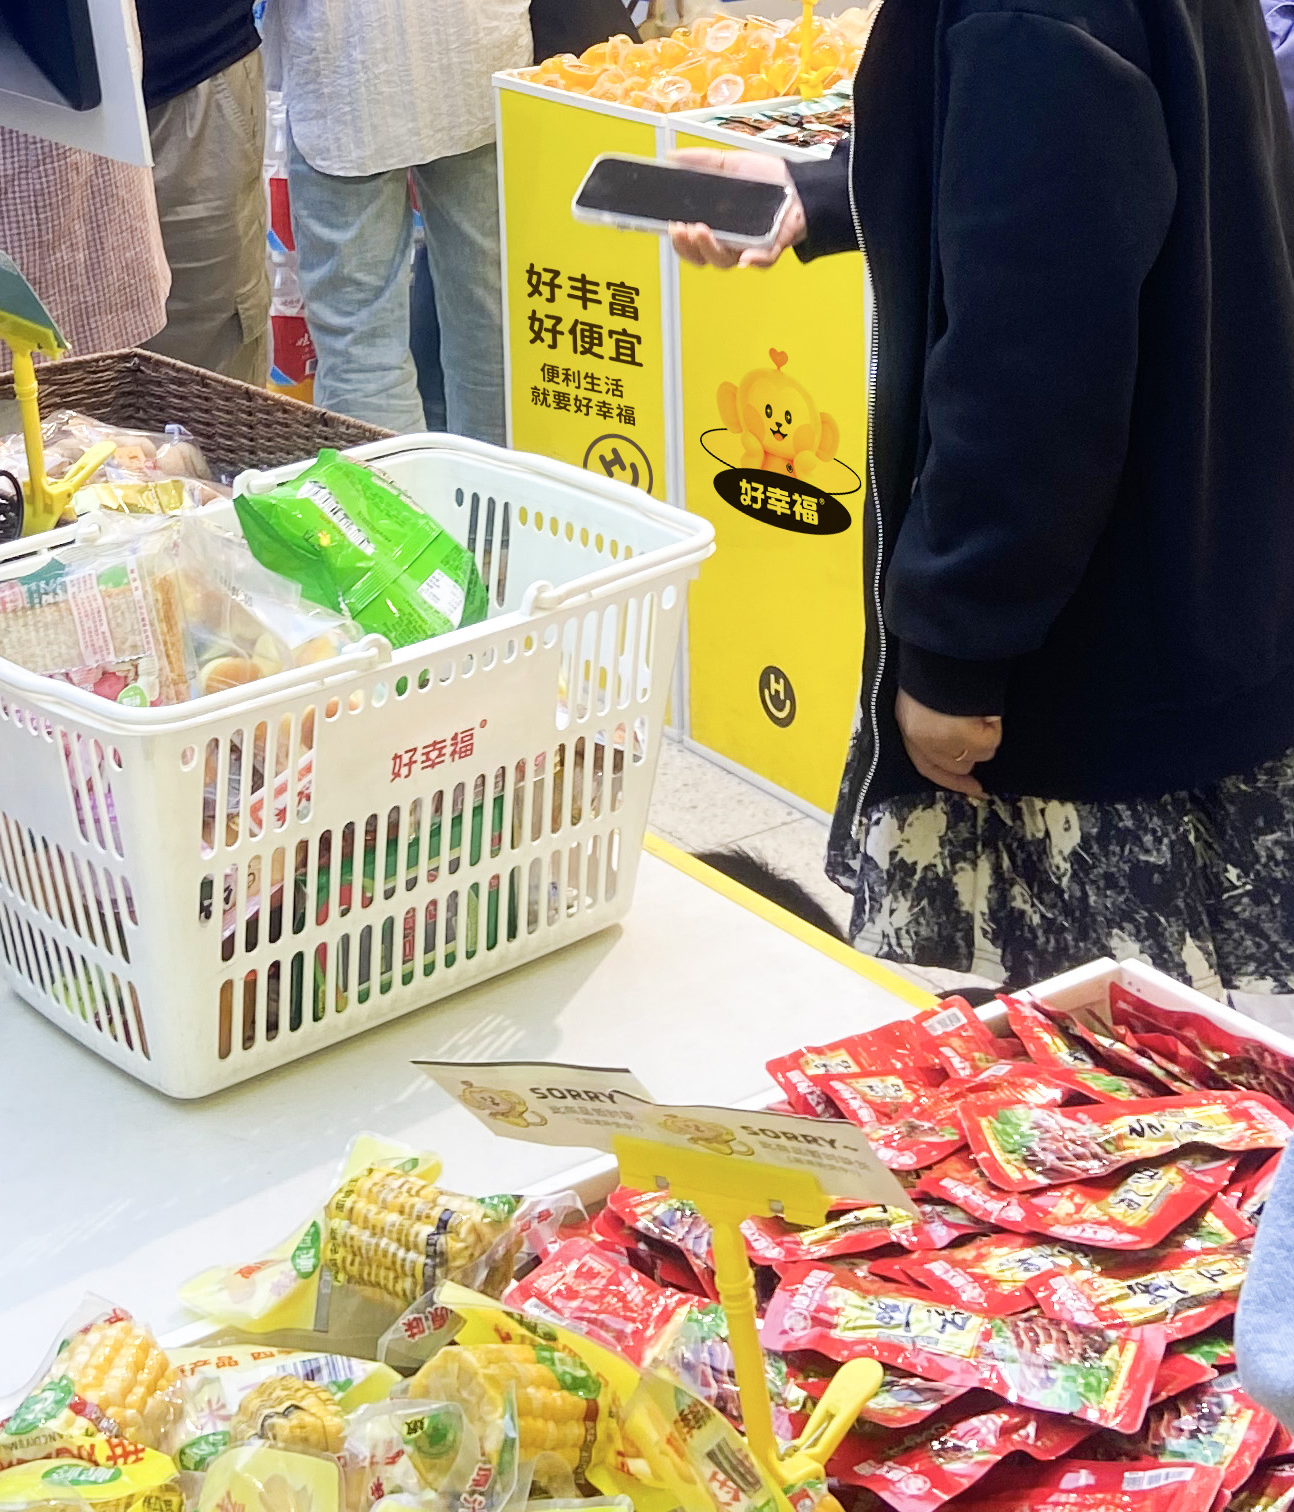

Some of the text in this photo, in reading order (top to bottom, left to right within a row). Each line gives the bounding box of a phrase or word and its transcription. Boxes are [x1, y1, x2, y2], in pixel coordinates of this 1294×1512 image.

[526, 263, 640, 321] 好丰富
[528, 310, 644, 368] 好便宜
[540, 363, 625, 399] 便利生活
[530, 386, 637, 427] 就要好幸福
[739, 479, 819, 526] 好幸福
[390, 727, 477, 781] 好幸福
